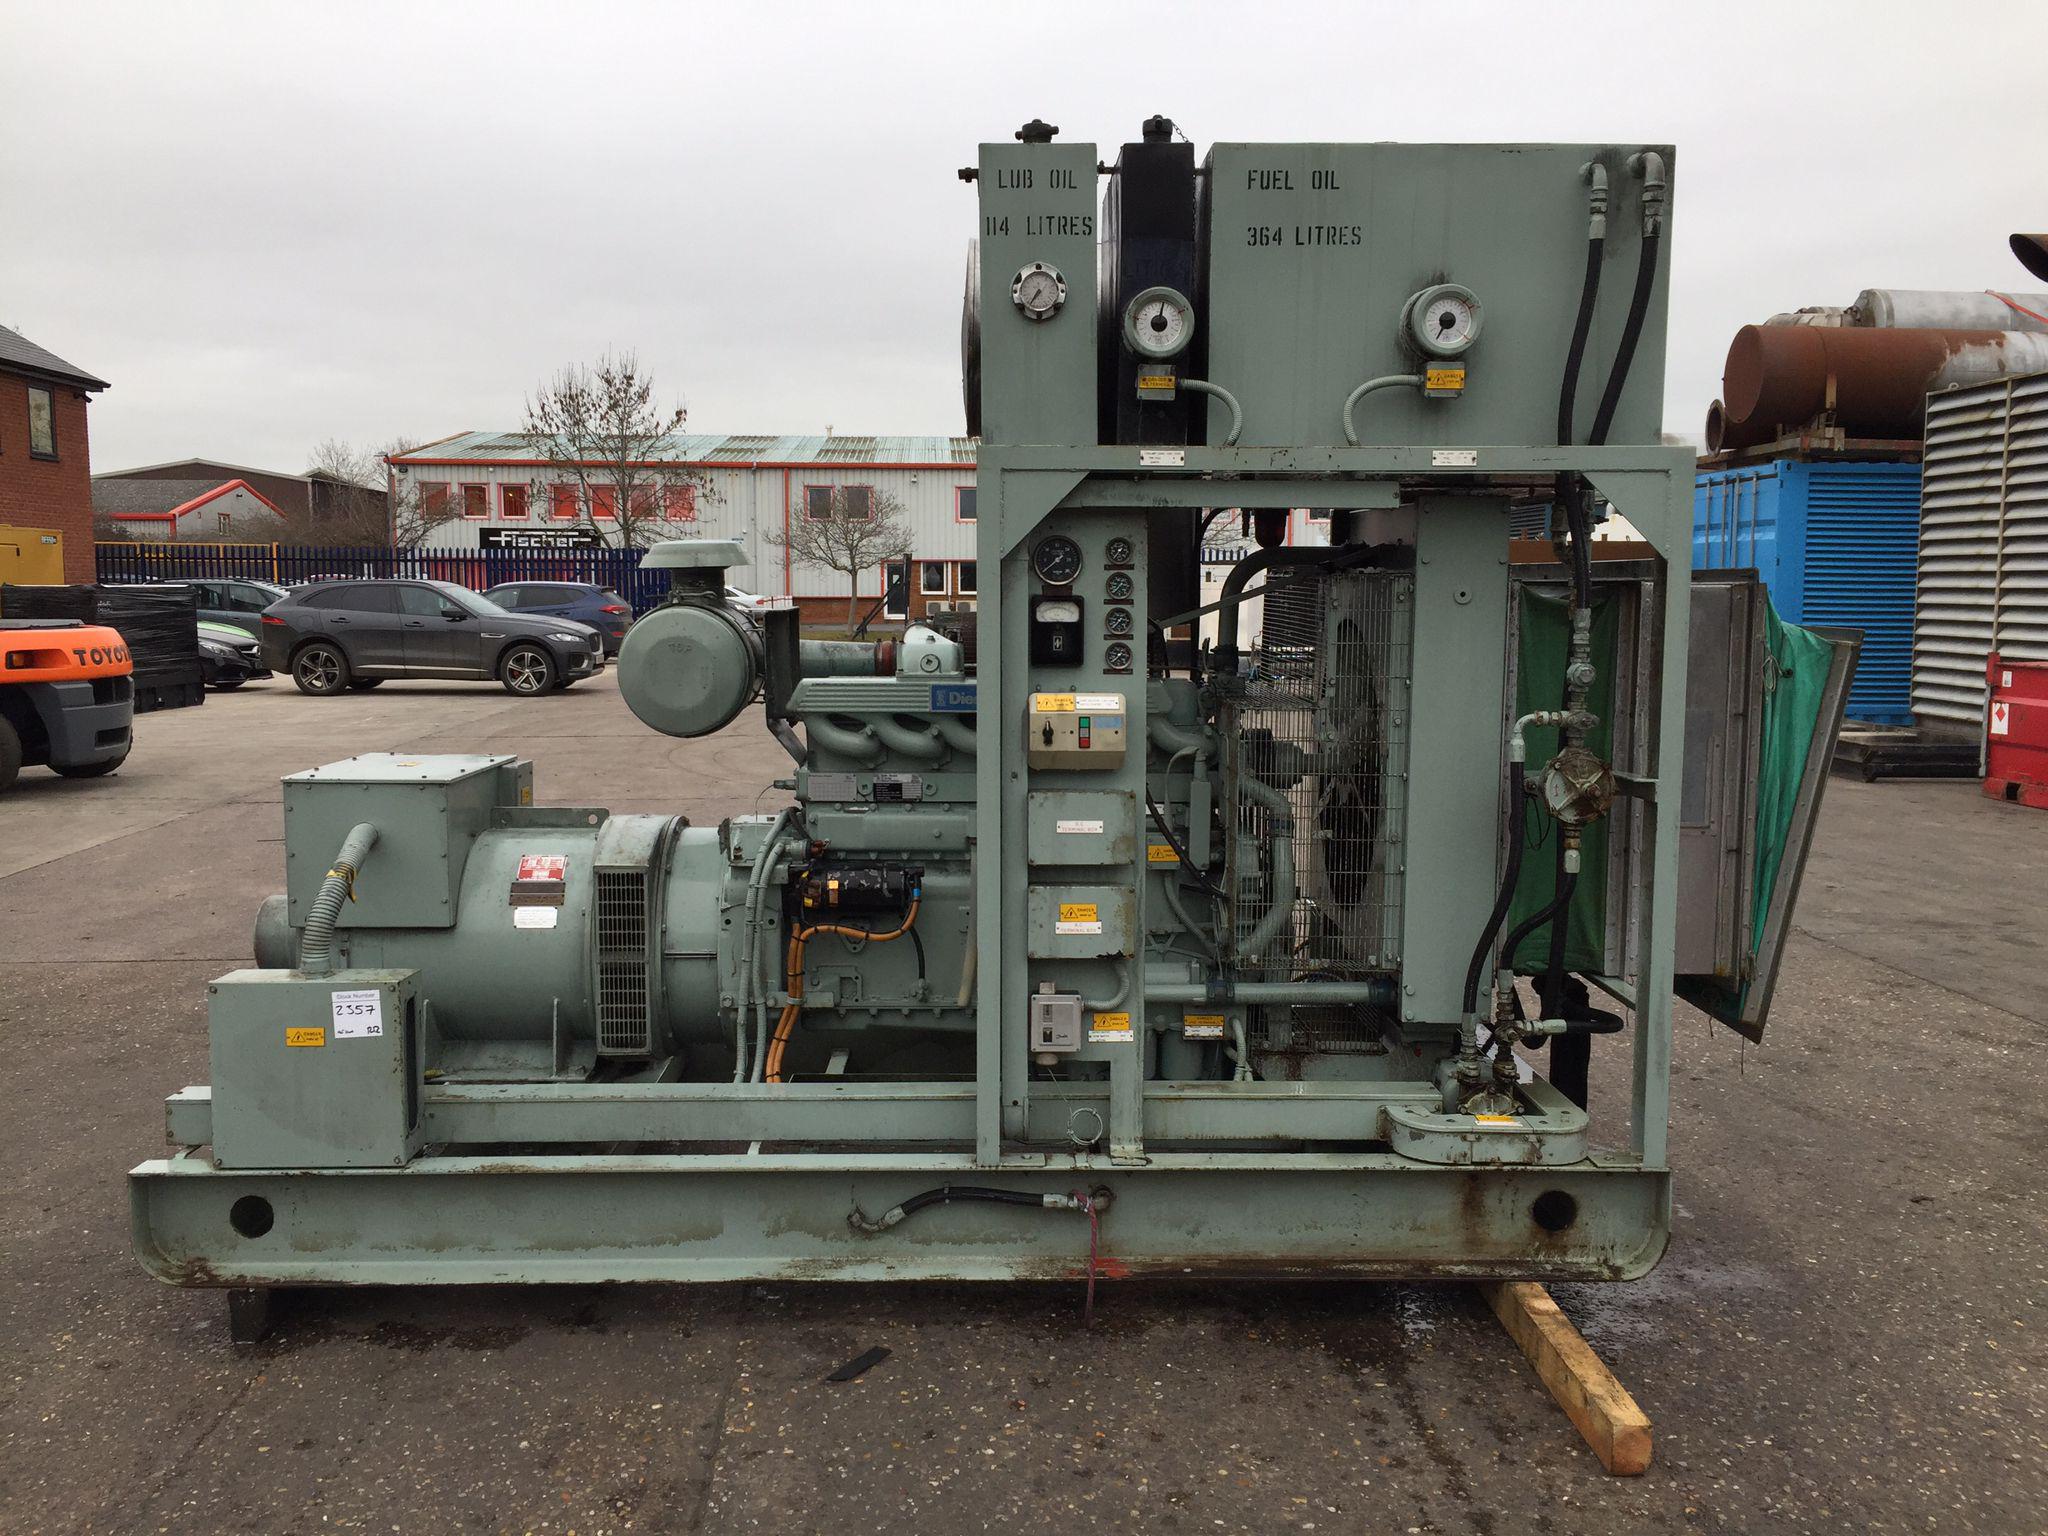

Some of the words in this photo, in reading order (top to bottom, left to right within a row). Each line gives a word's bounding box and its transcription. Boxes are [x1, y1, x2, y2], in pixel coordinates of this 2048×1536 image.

[998, 169, 1033, 189] LUB
[1049, 169, 1078, 189] OIL
[1247, 169, 1294, 190] FUEL
[1311, 169, 1340, 190] OIL
[986, 216, 1010, 236] 114
[1026, 215, 1093, 236] LITRES
[1247, 226, 1282, 246] 364
[1295, 225, 1361, 246] LITRES
[335, 1004, 376, 1016] 2357
